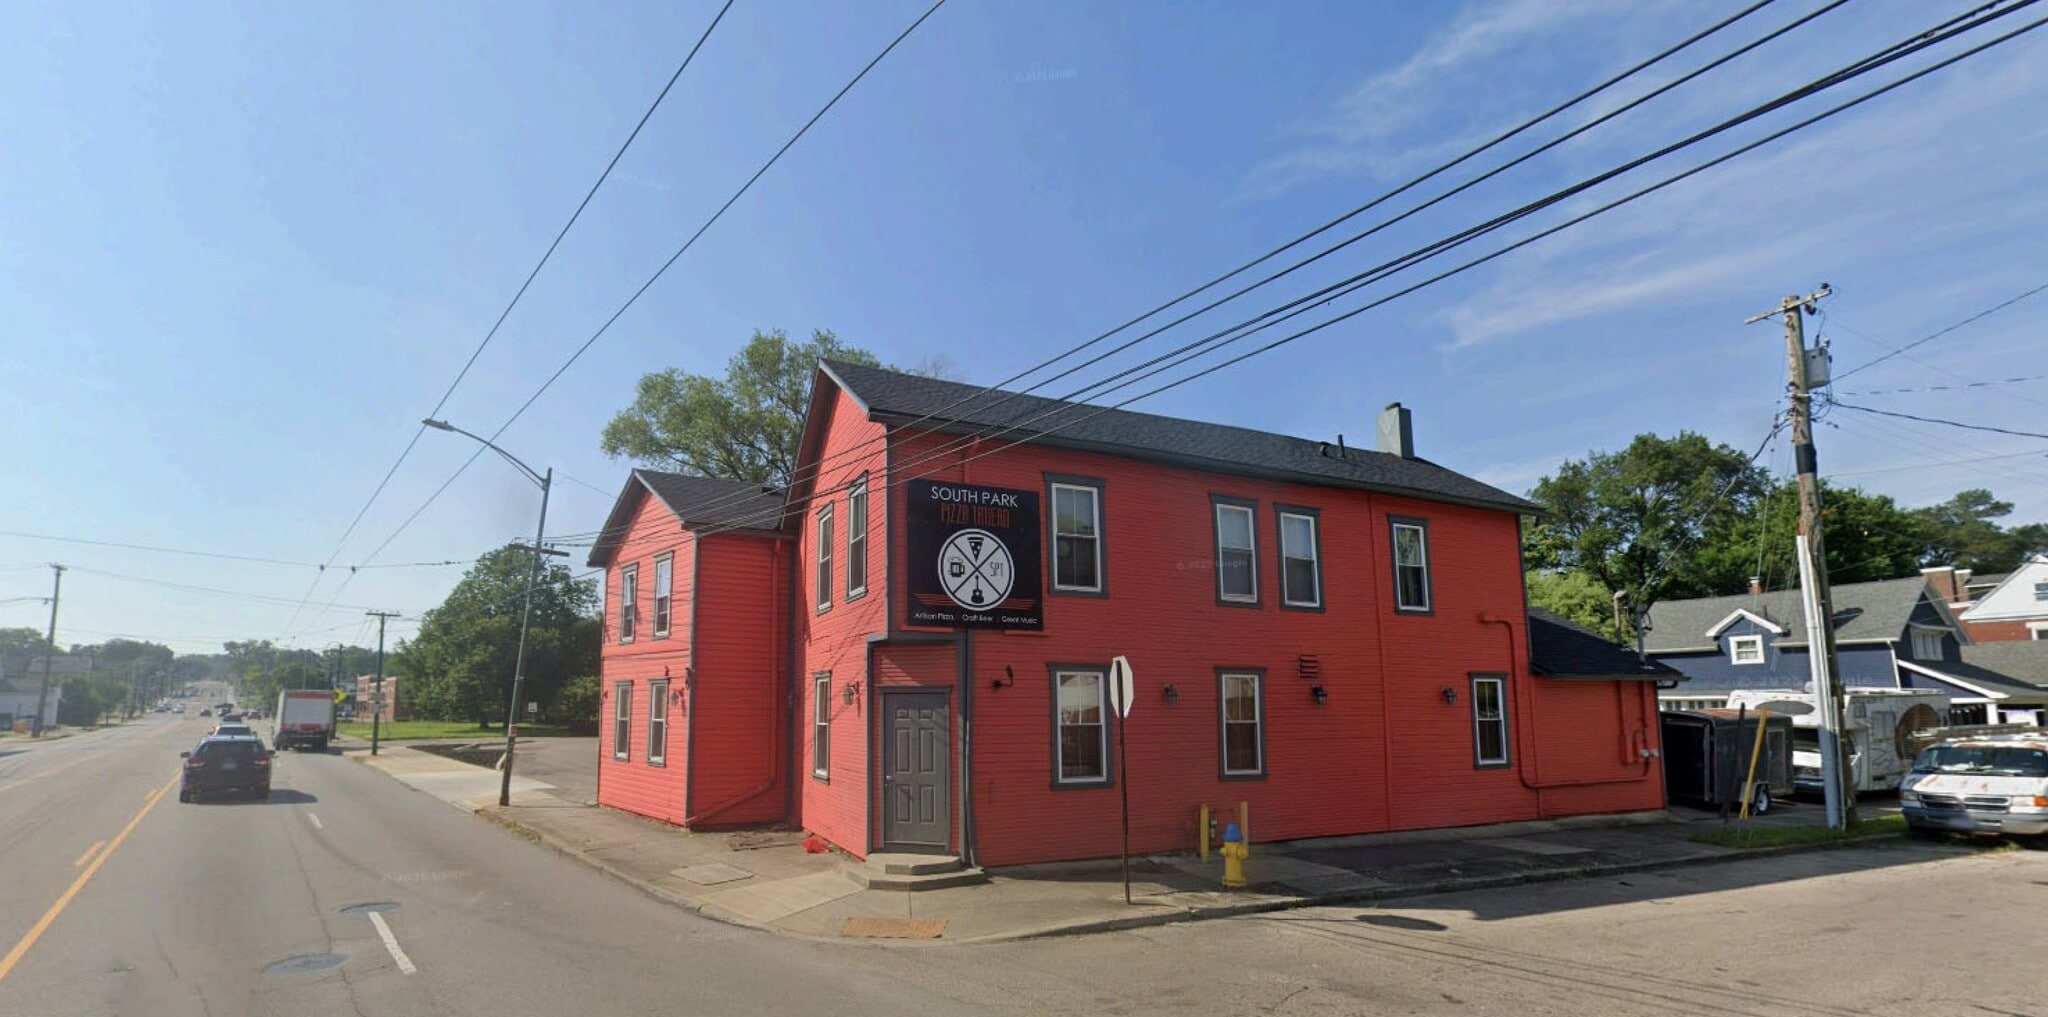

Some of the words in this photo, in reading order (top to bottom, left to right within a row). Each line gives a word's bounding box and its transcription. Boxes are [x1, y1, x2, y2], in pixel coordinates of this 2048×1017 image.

[930, 486, 978, 504] SOUTH
[982, 491, 1018, 508] PARK
[941, 502, 969, 524] PIZZA
[973, 504, 1010, 529] TAVERN
[990, 561, 1004, 578] SPT
